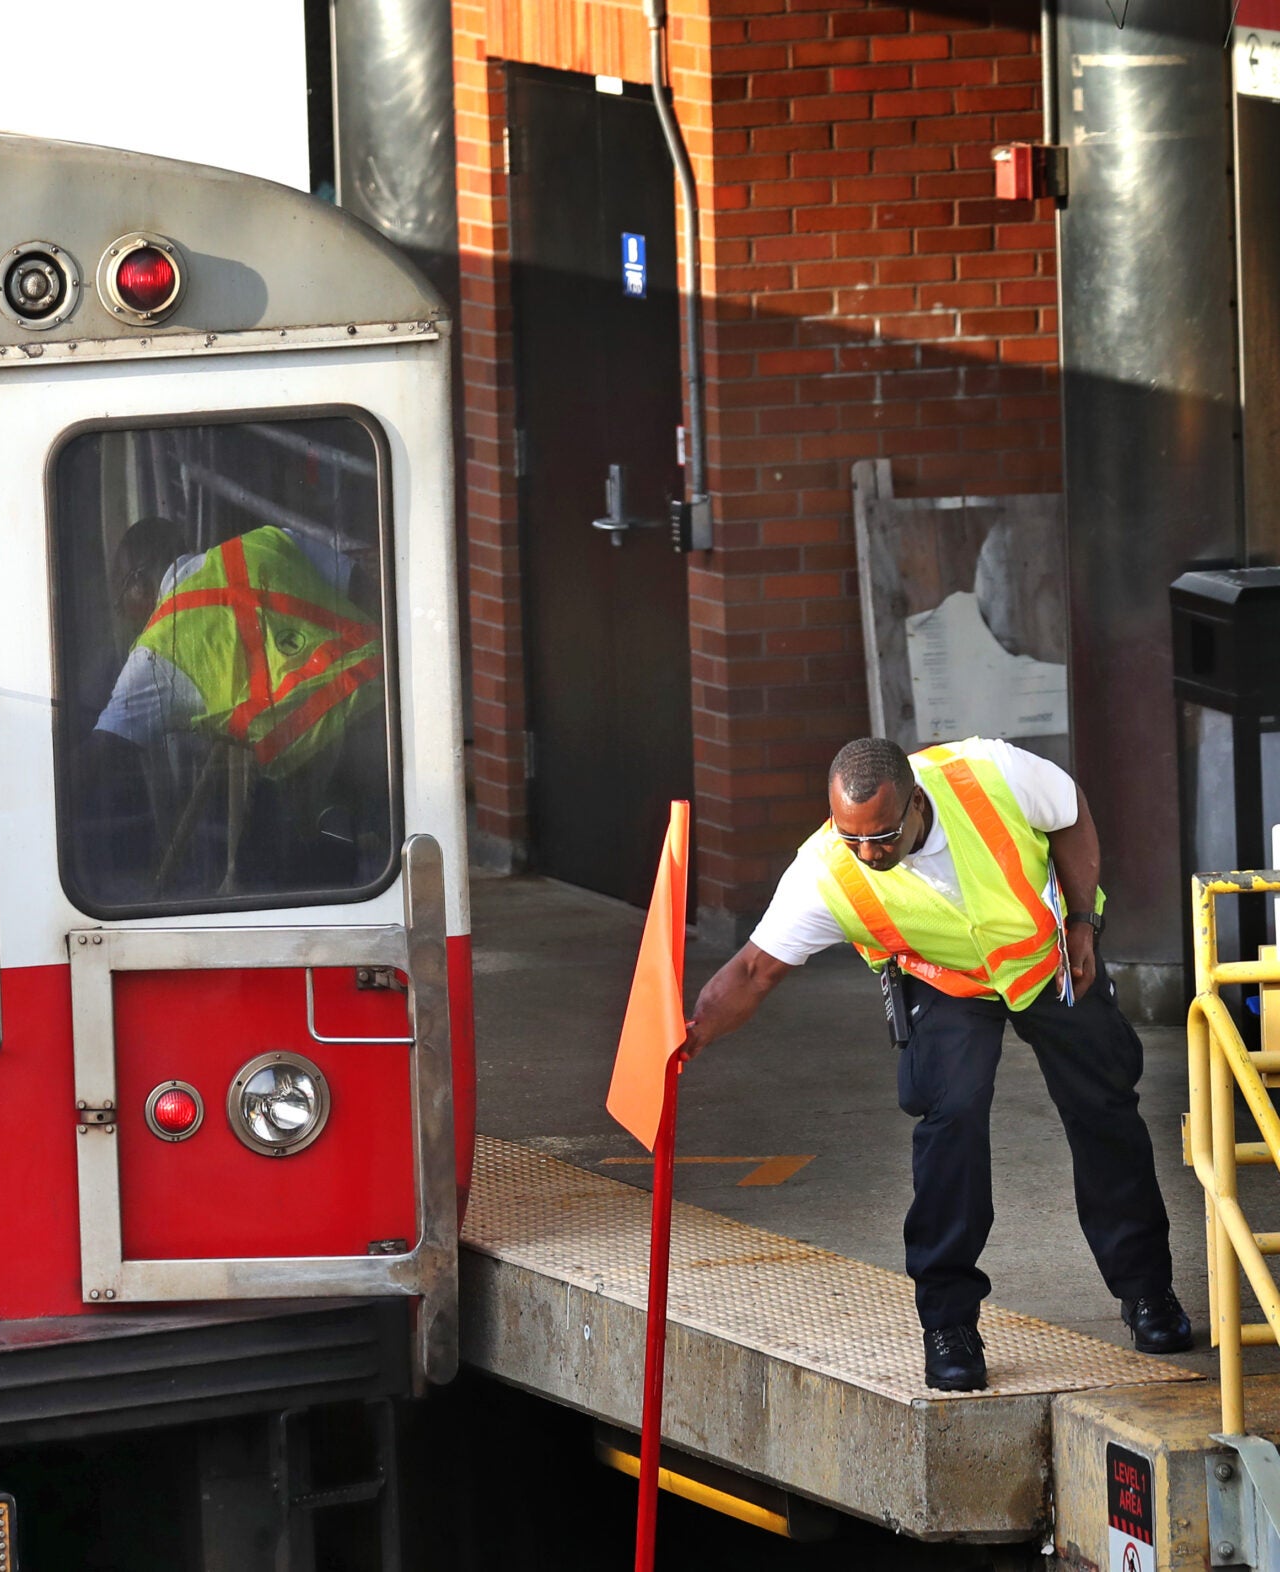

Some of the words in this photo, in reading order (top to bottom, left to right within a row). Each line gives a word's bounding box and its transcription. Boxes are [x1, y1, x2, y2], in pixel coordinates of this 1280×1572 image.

[1113, 1458, 1140, 1491] LEVEL
[1141, 1473, 1146, 1495] 1
[1120, 1488, 1143, 1518] AREA
